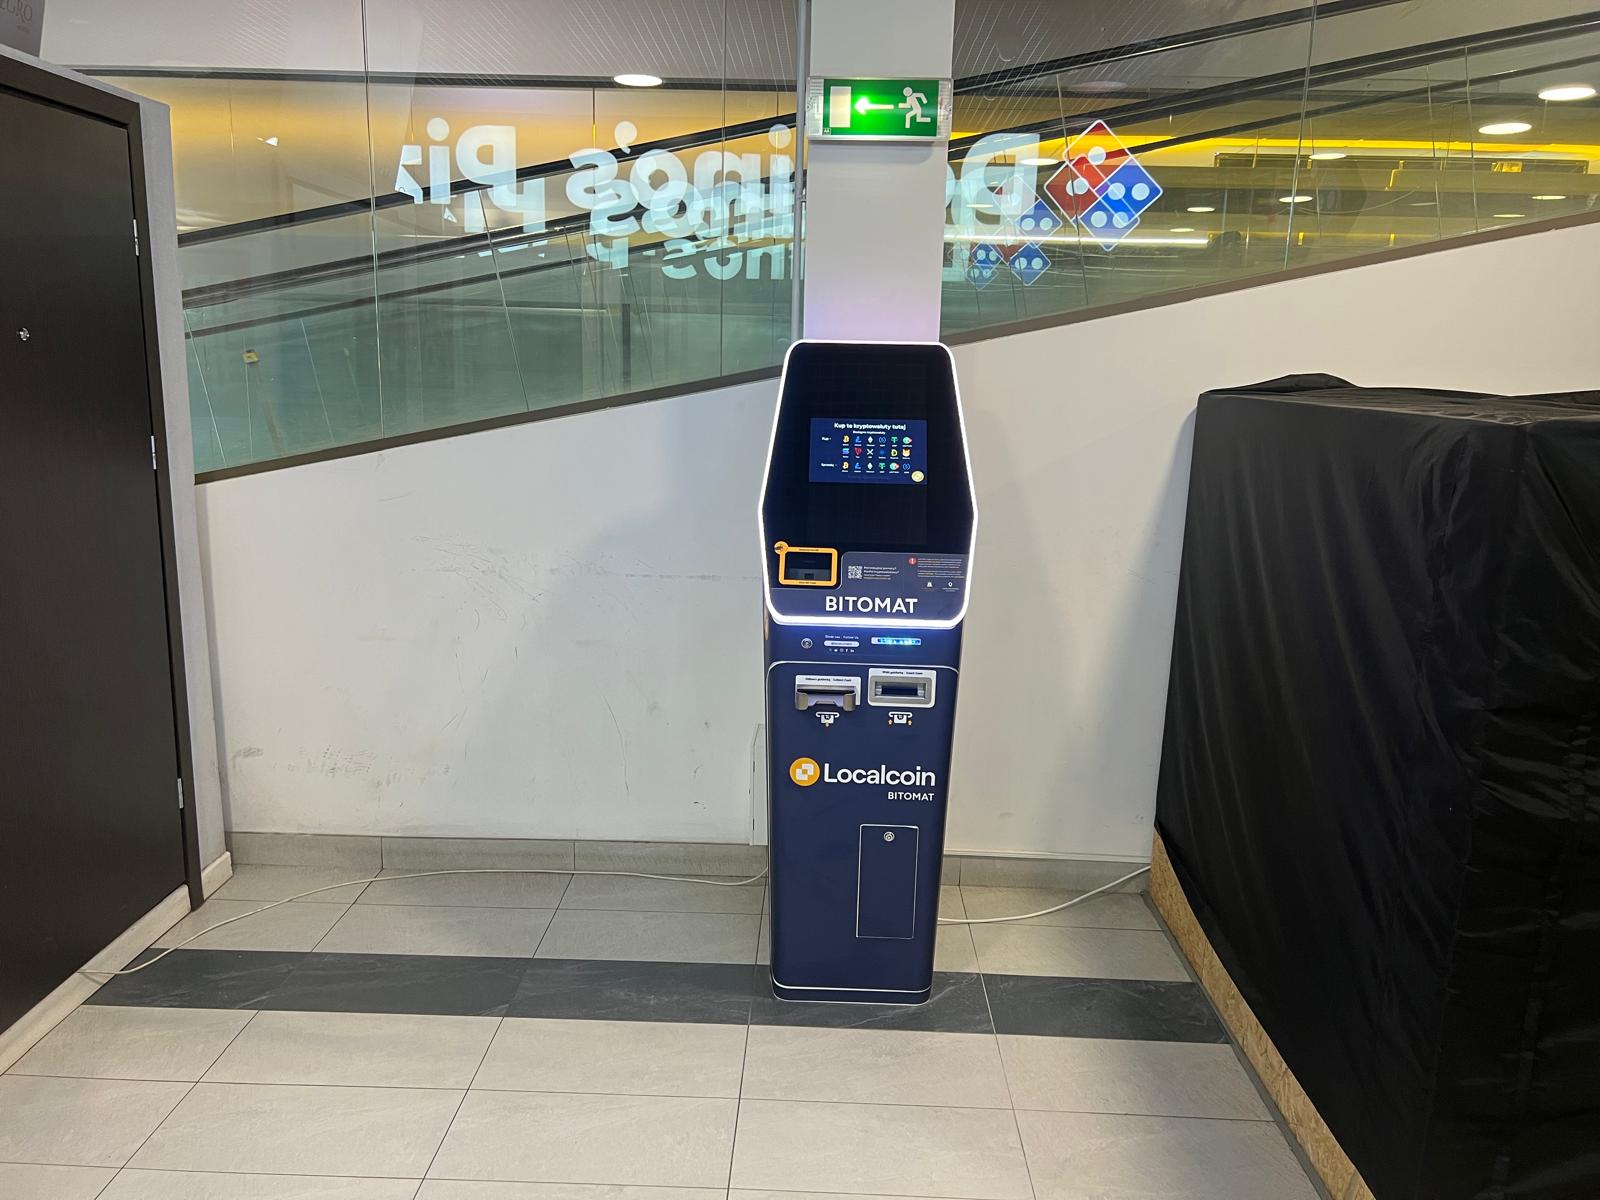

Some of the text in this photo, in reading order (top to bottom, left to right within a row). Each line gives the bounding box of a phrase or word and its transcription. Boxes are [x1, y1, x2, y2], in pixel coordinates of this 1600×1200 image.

[854, 423, 891, 431] kryptowaluty
[825, 595, 918, 613] BITOMAT
[824, 763, 936, 786] Localcoin
[887, 791, 935, 801] BITOMAT
